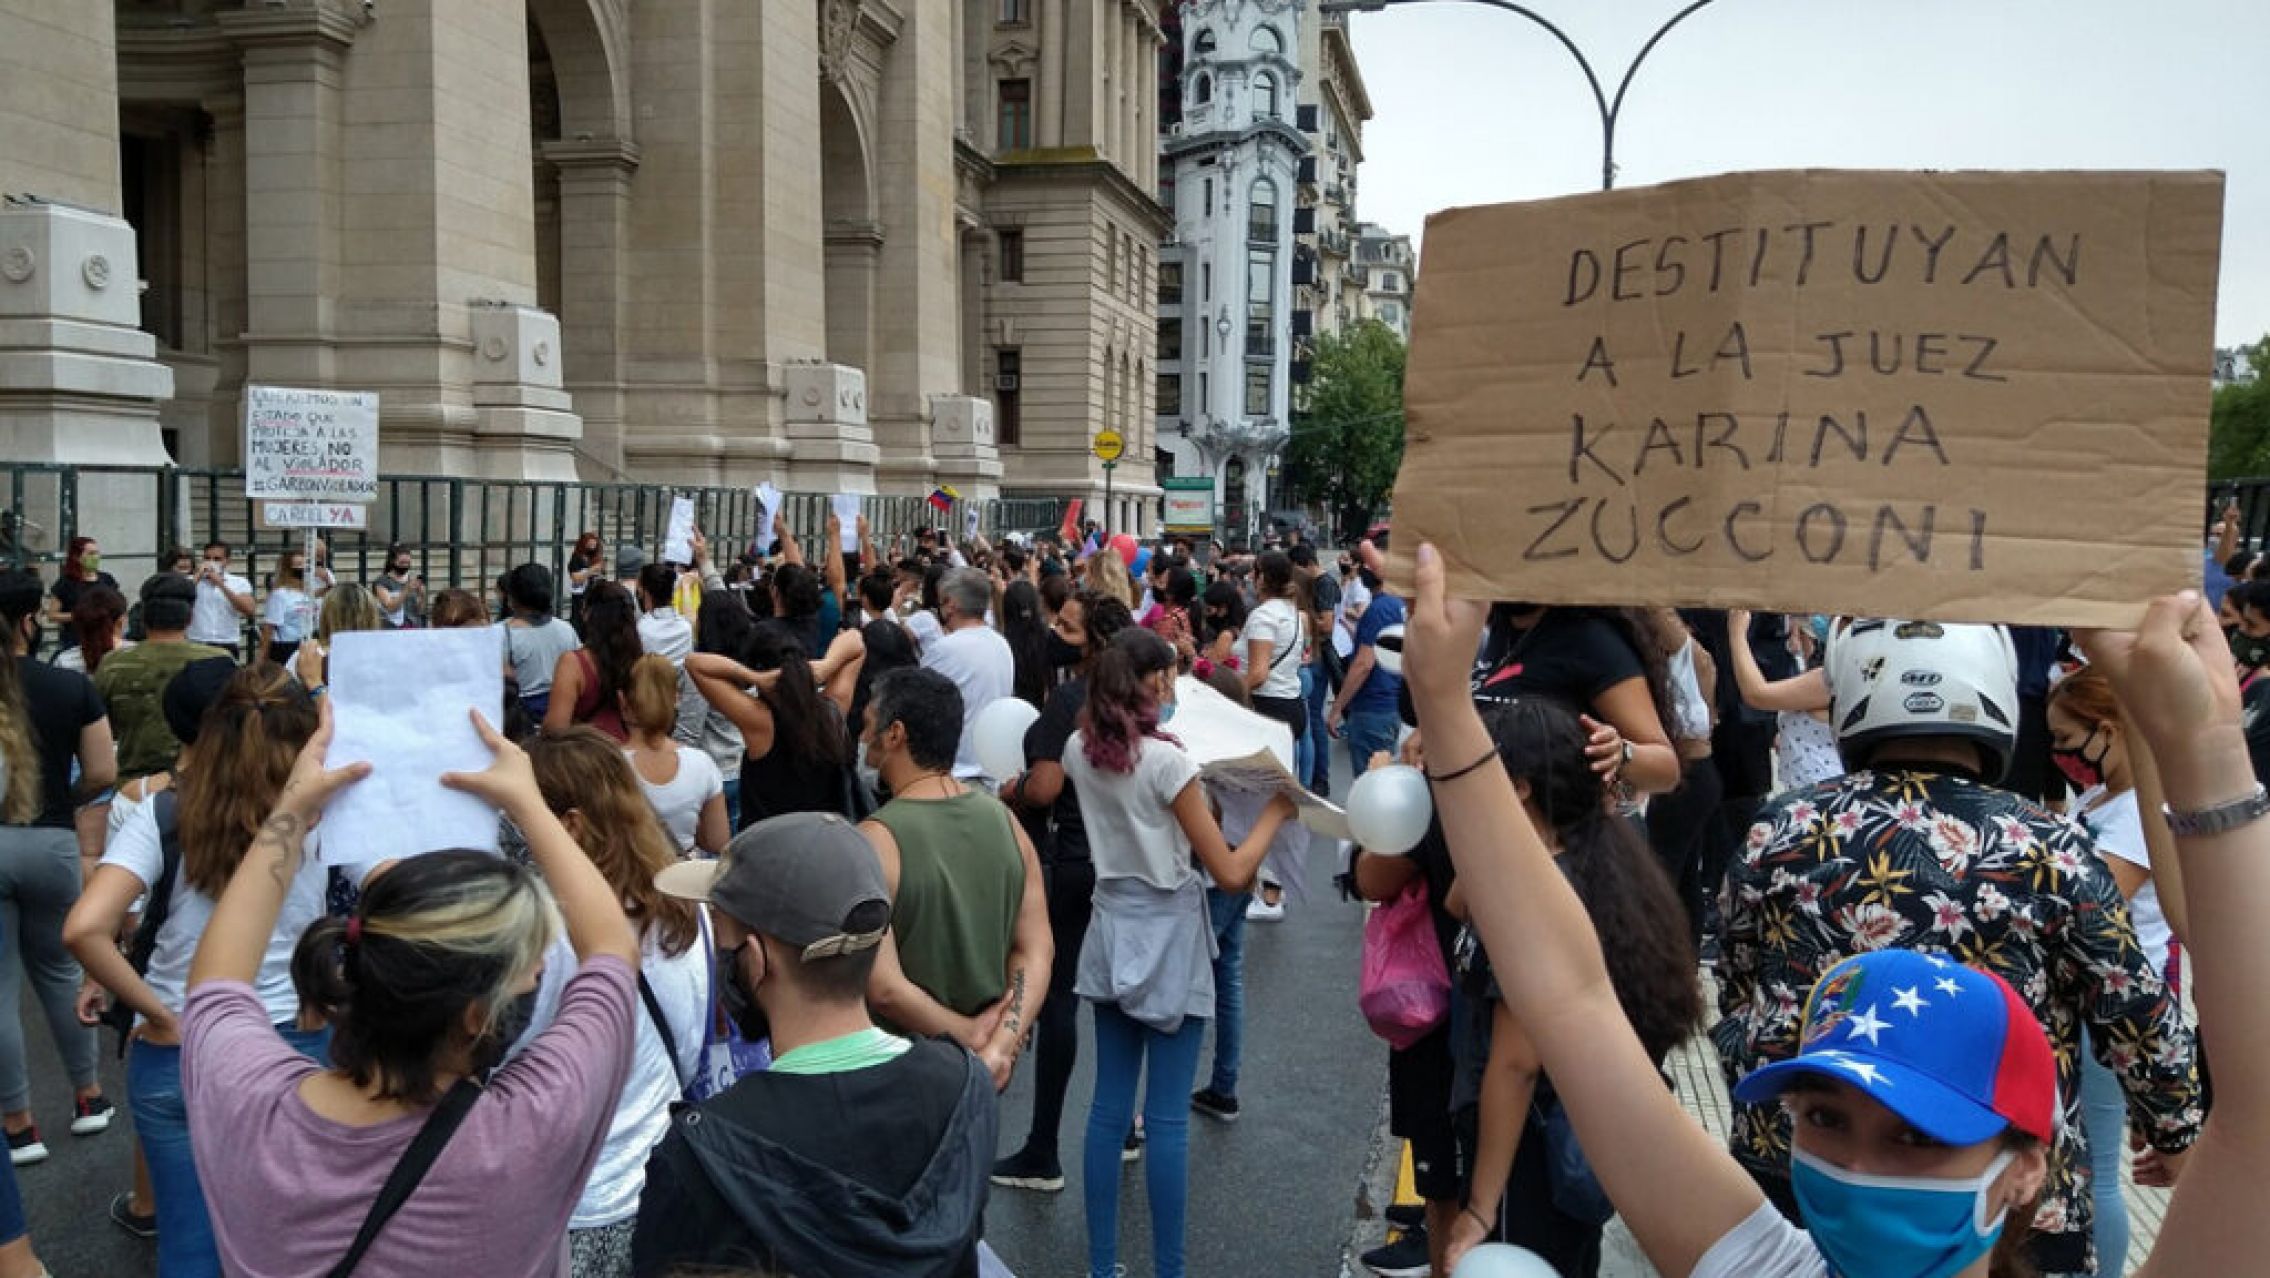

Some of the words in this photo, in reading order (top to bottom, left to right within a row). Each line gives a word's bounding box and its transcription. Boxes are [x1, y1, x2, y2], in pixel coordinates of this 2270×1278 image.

[1563, 221, 2080, 306] DESTITUYAN
[1576, 336, 1618, 388] A
[1669, 321, 1752, 381] LA
[1803, 331, 2008, 382] JUEZ
[316, 426, 327, 438] A
[332, 427, 358, 439] LAS
[327, 442, 351, 456] NO
[1569, 405, 1950, 486] KARINA
[255, 456, 271, 471] AL
[283, 455, 364, 472] VIOLADOR
[329, 507, 354, 522] YA
[1522, 496, 1987, 573] ZUCCONI
